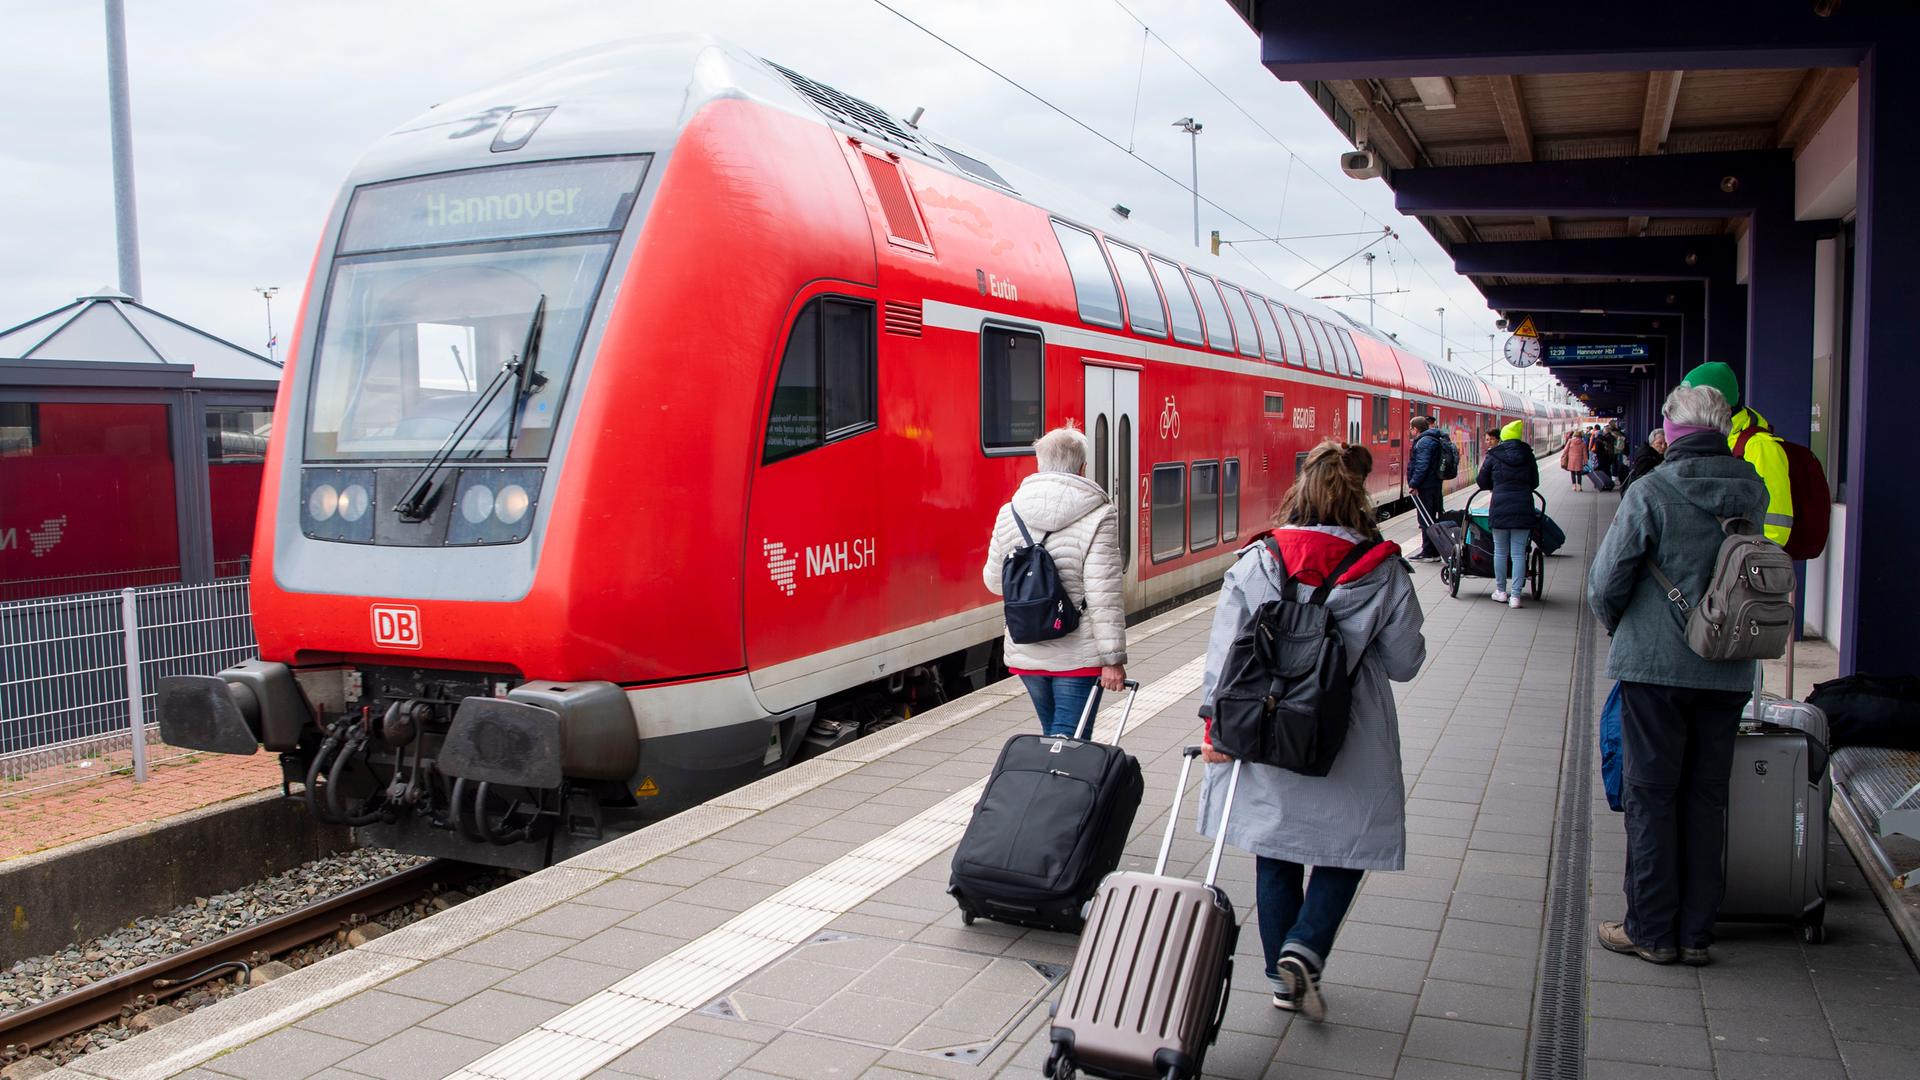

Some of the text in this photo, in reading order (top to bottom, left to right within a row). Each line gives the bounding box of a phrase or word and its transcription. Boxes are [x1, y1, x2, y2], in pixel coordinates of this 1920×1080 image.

[426, 185, 581, 226] Hannover
[989, 273, 1018, 302] Eutin
[1292, 407, 1308, 429] REGIO
[1616, 406, 1623, 414] B
[1142, 476, 1149, 508] 2
[805, 537, 875, 578] NAH.SH
[377, 610, 415, 642] DB
